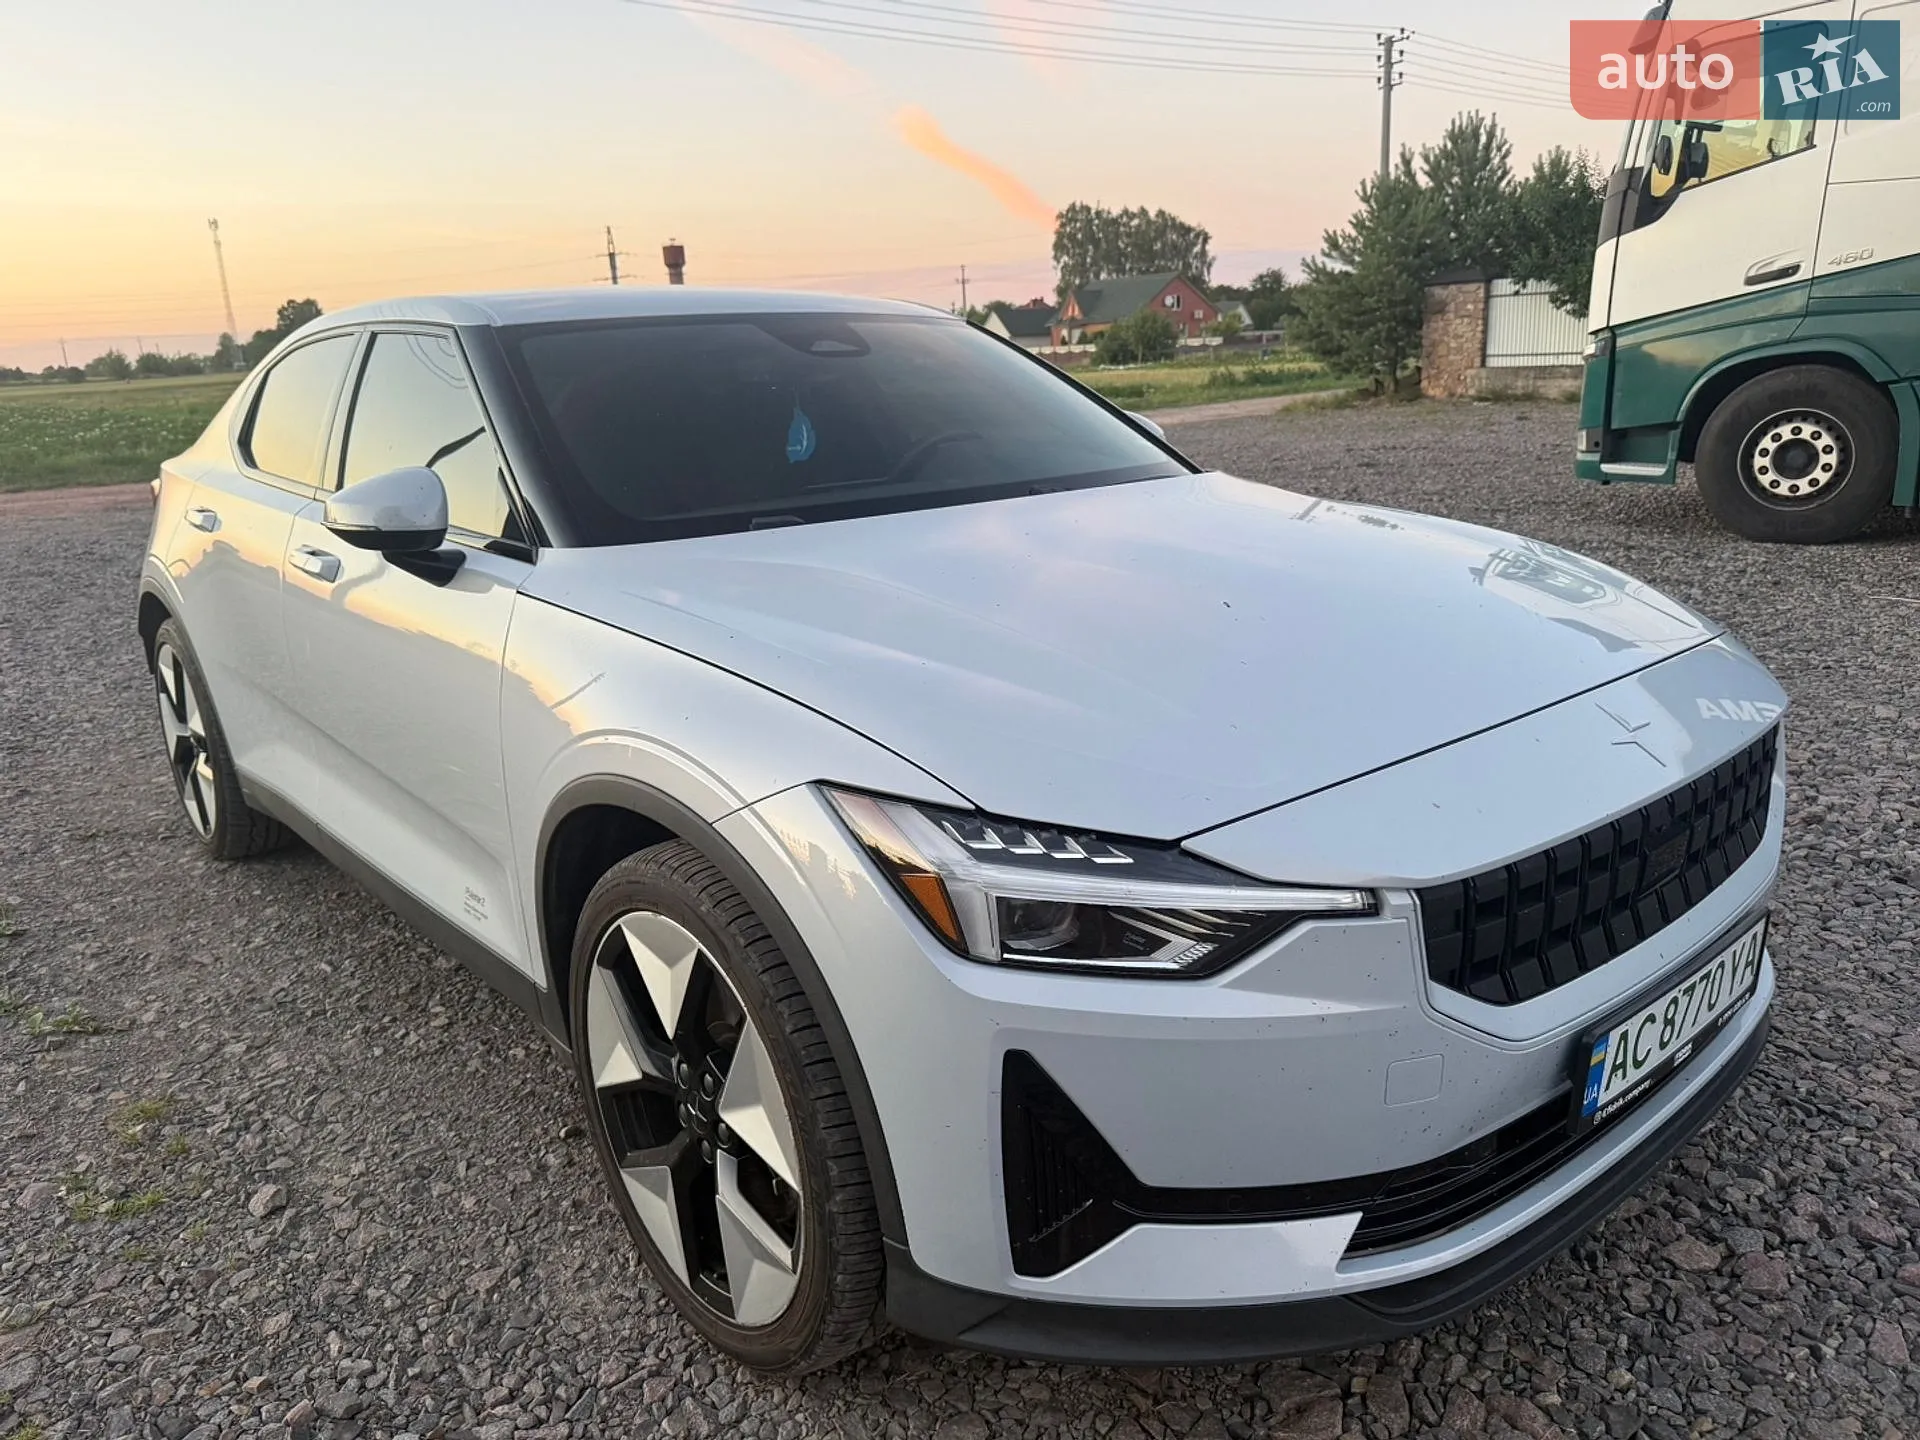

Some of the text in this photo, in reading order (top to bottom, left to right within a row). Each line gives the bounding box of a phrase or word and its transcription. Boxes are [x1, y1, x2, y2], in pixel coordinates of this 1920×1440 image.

[1827, 247, 1874, 267] 460
[1604, 1012, 1657, 1093] AC
[1659, 959, 1726, 1051] 8770
[1729, 931, 1758, 996] YA
[1582, 1082, 1599, 1105] UA
